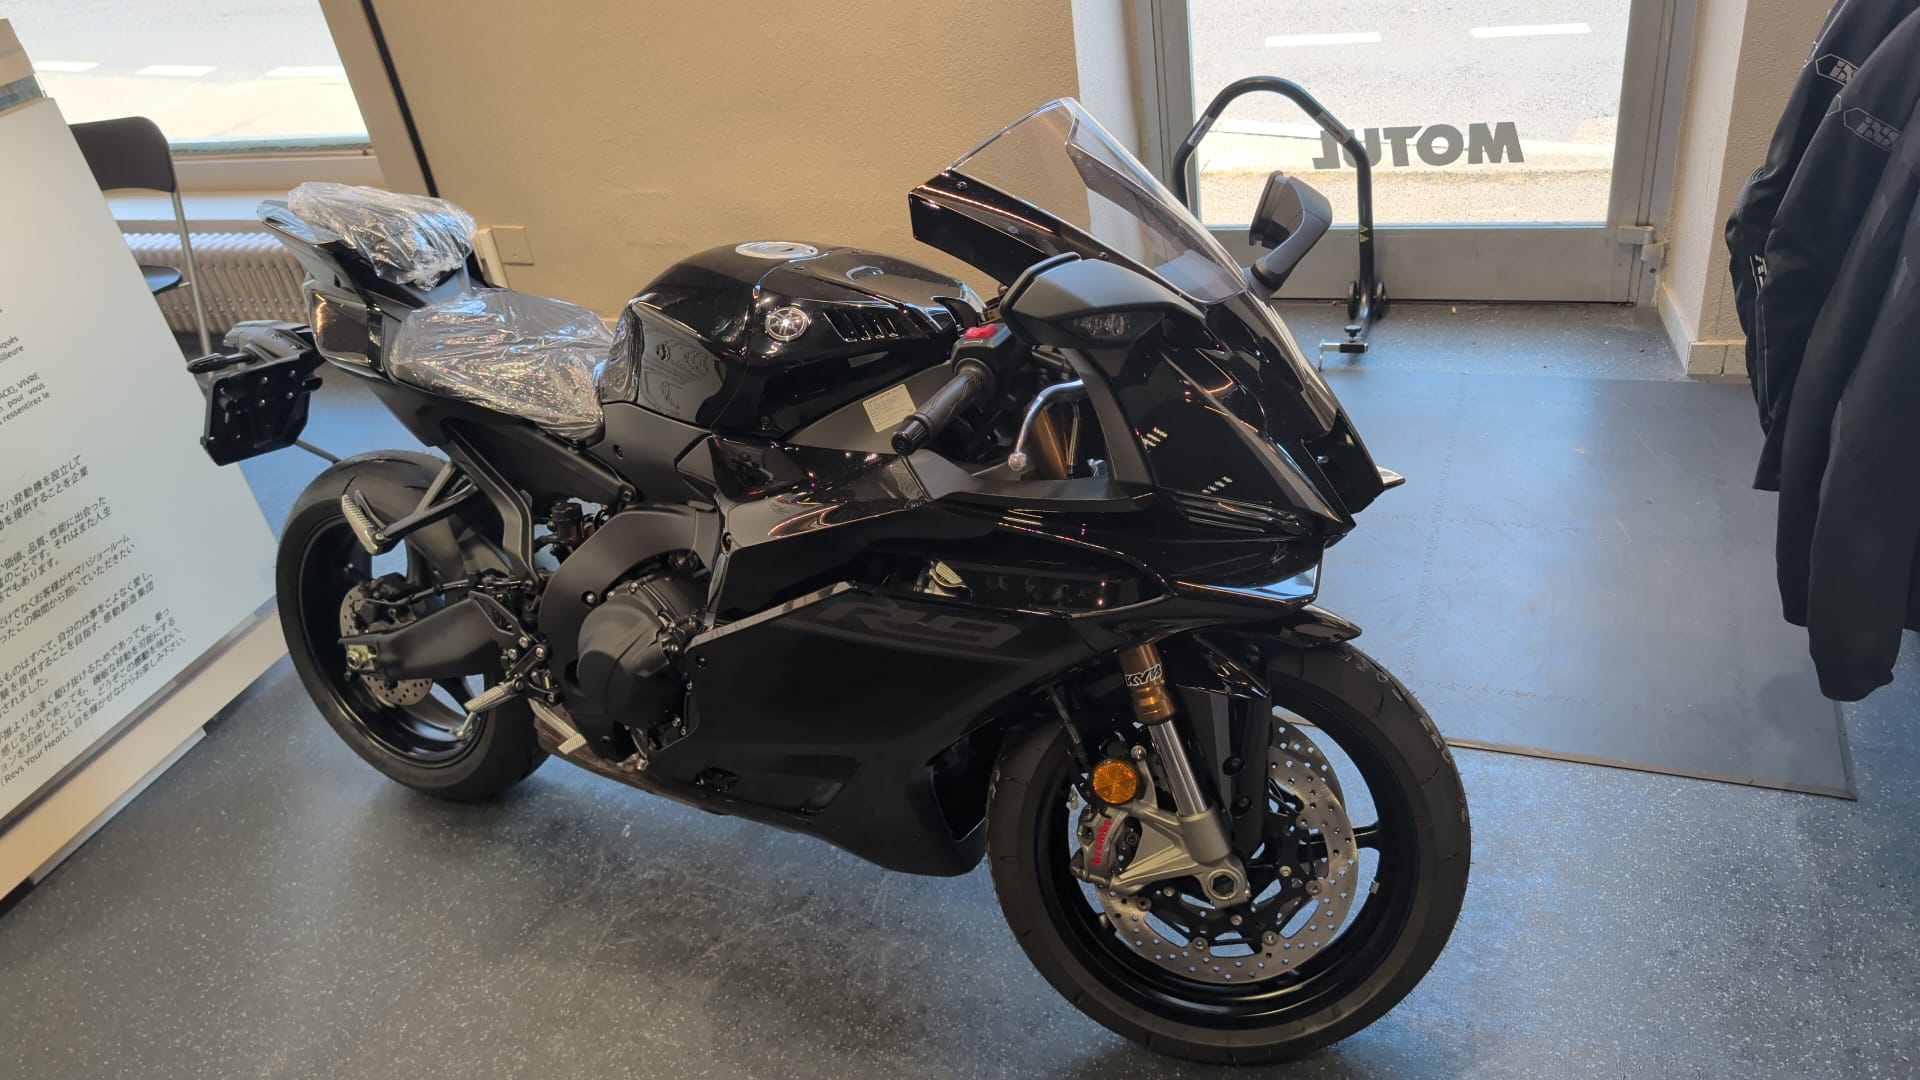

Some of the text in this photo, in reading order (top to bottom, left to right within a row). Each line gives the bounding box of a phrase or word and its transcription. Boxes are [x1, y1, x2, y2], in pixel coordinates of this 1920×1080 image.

[16, 372, 41, 388] VIVRE
[3, 397, 42, 422] ressentirez
[41, 392, 50, 400] le
[7, 382, 45, 408] pour vous
[0, 676, 48, 718] されました。
[24, 748, 43, 766] Your
[1090, 819, 1112, 866] brembo
